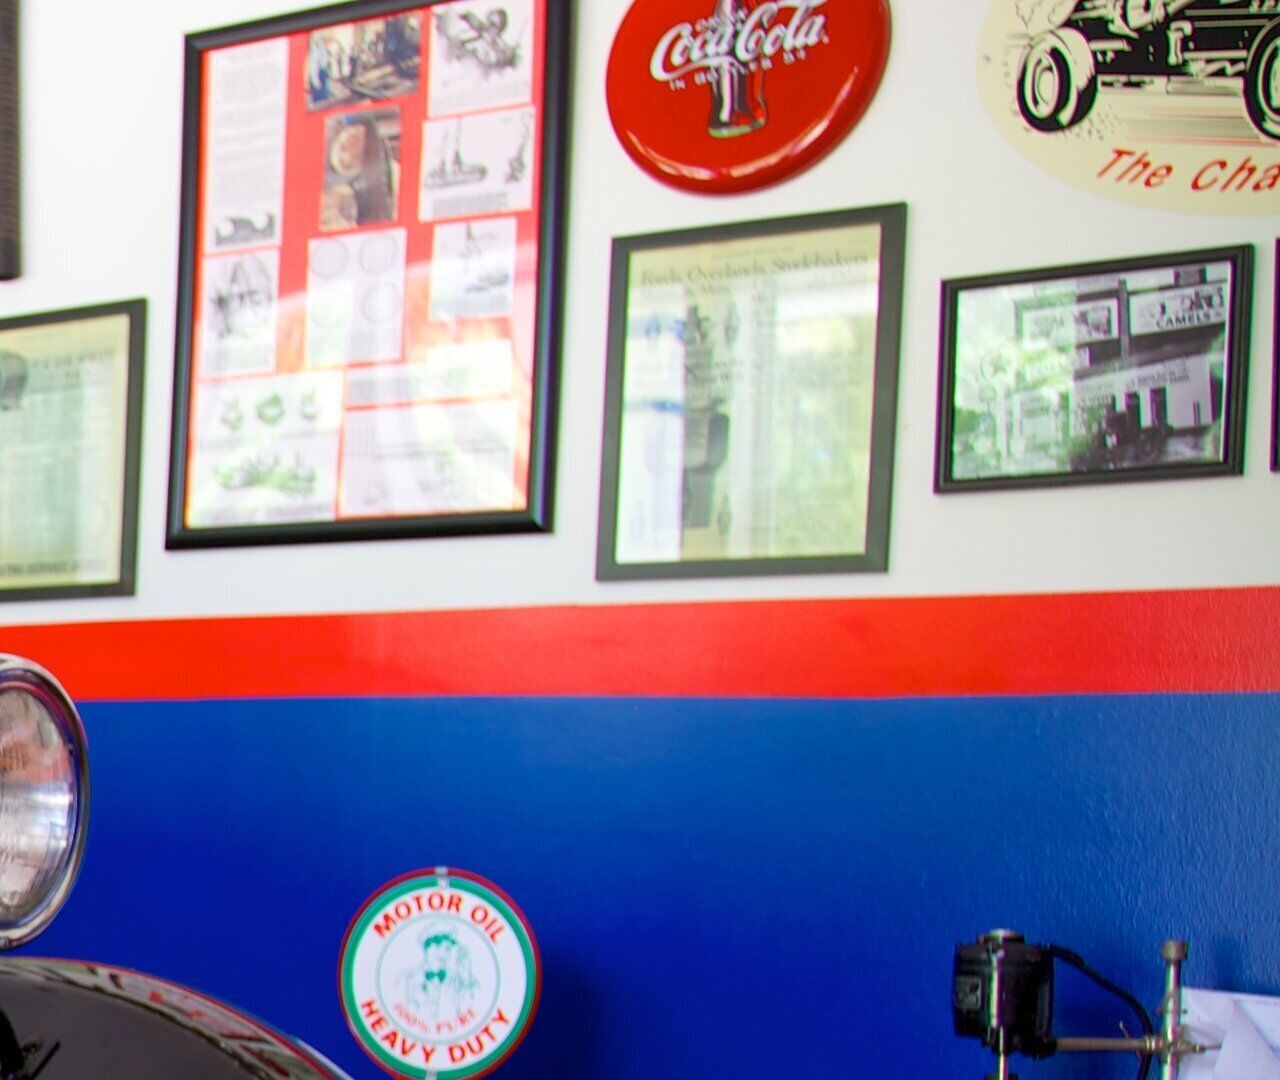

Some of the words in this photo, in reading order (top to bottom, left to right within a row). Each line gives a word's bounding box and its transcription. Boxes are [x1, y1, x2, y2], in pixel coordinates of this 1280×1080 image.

[1096, 148, 1173, 188] The
[373, 891, 463, 939] MOTOR
[470, 905, 506, 945] OIL
[360, 997, 436, 1065] HEAVY
[448, 1008, 510, 1064] DUTY
[435, 1007, 478, 1035] PURE
